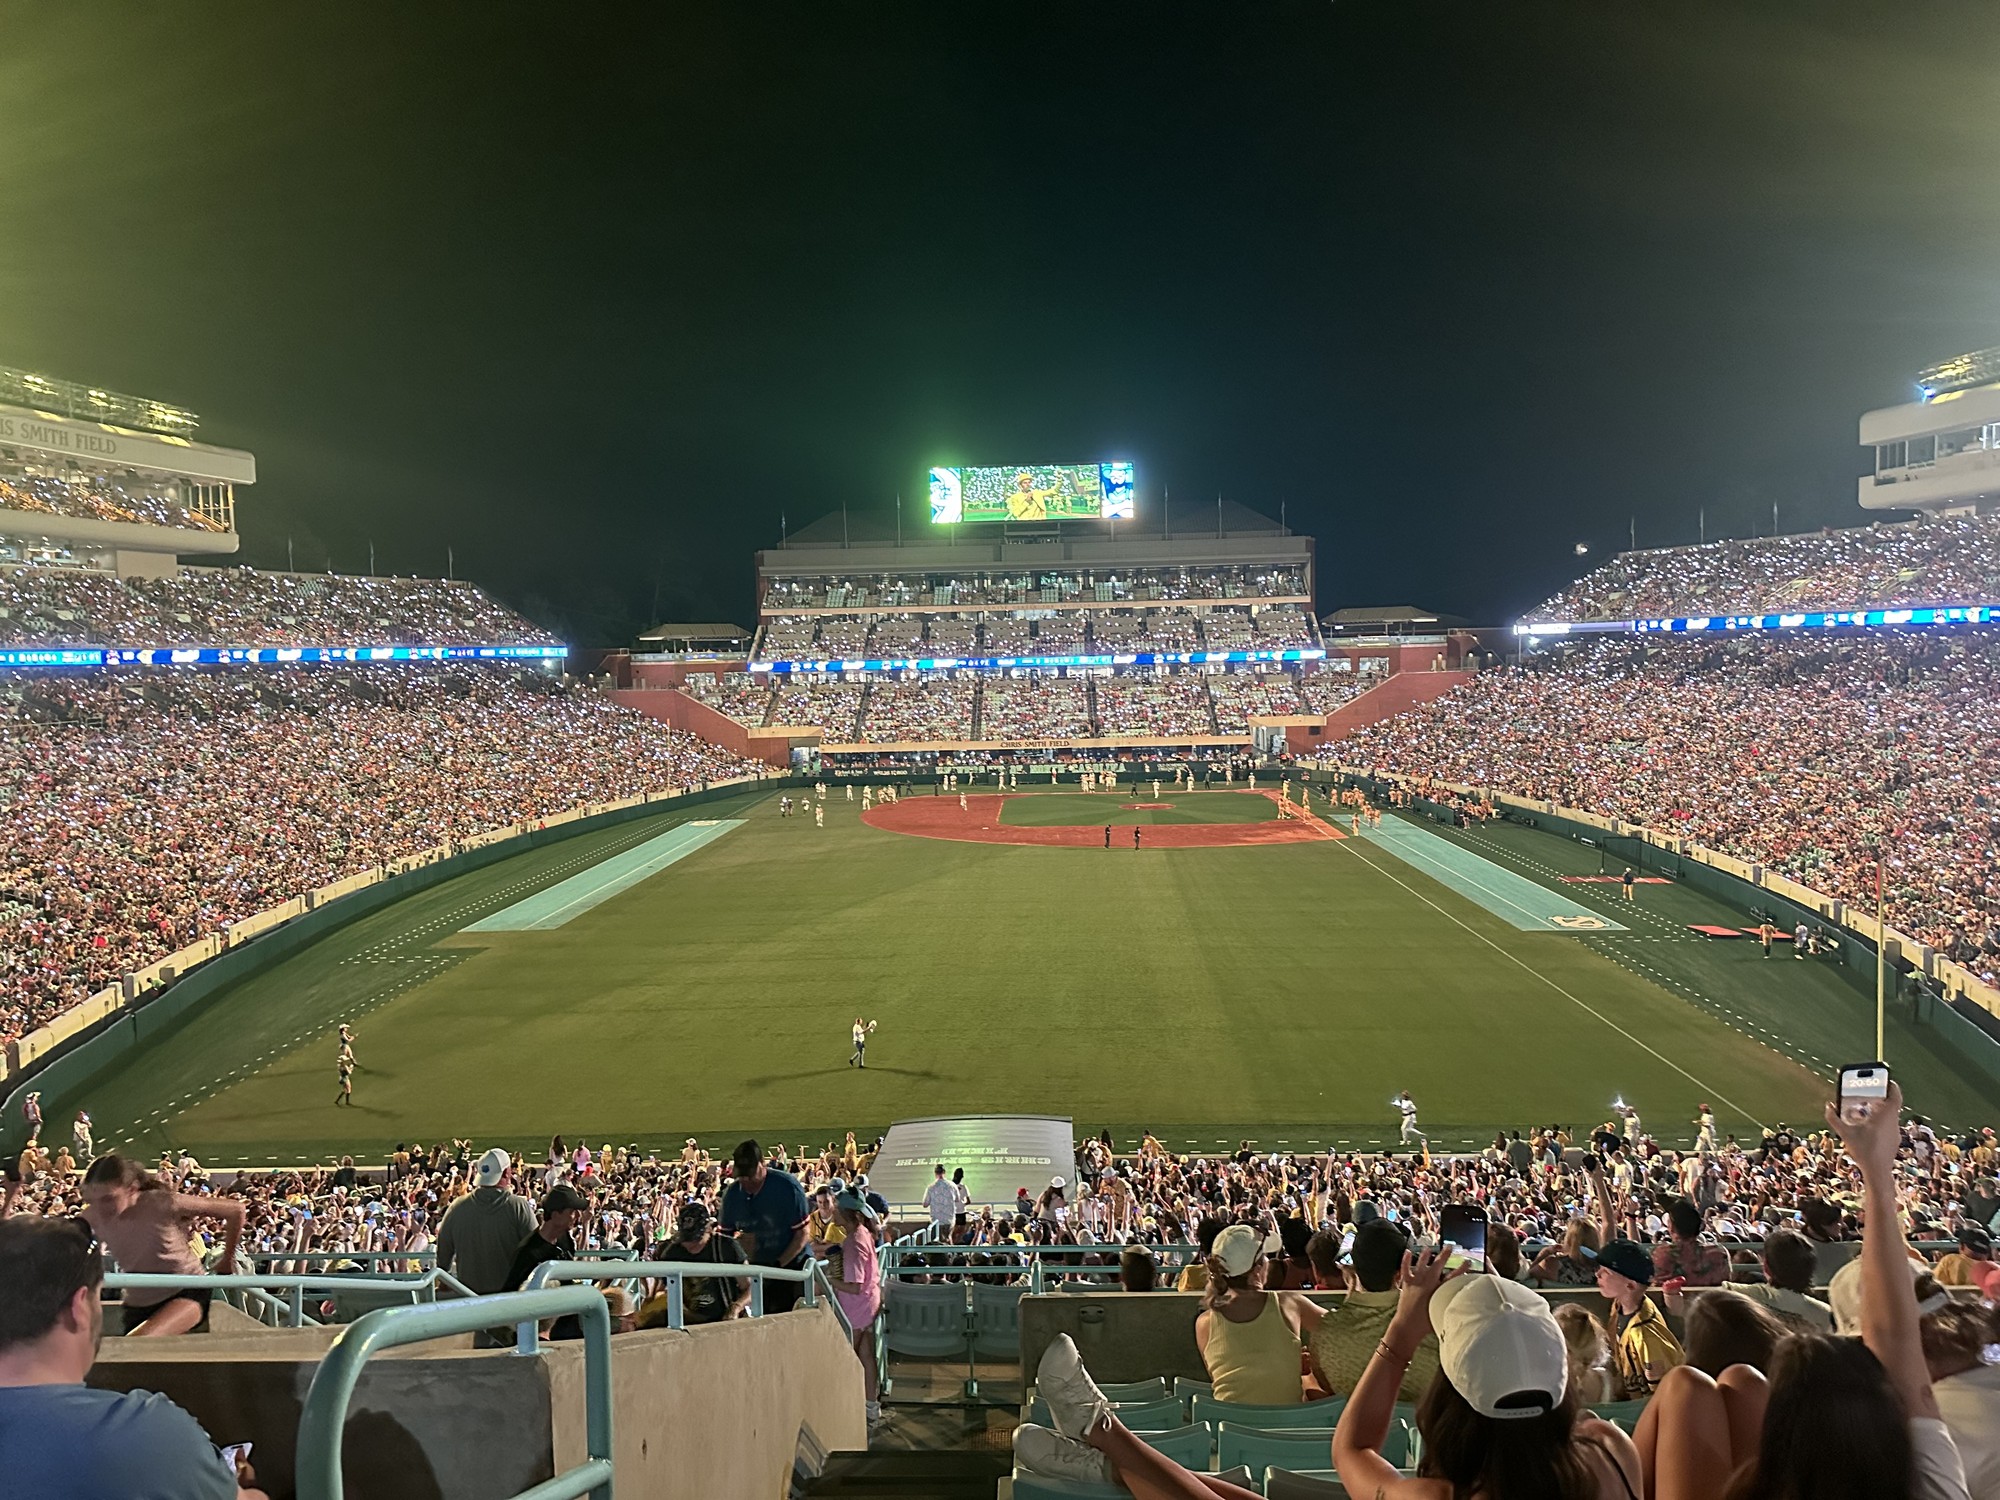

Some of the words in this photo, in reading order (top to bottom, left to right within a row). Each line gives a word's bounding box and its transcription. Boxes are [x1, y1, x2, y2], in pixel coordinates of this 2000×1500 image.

[20, 422, 69, 447] SMITH
[75, 433, 117, 455] FIELD
[1000, 741, 1022, 749] CHRIS
[941, 1147, 1009, 1155] FIELD
[895, 1156, 972, 1167] SMITH
[981, 1156, 1051, 1165] CHRIS
